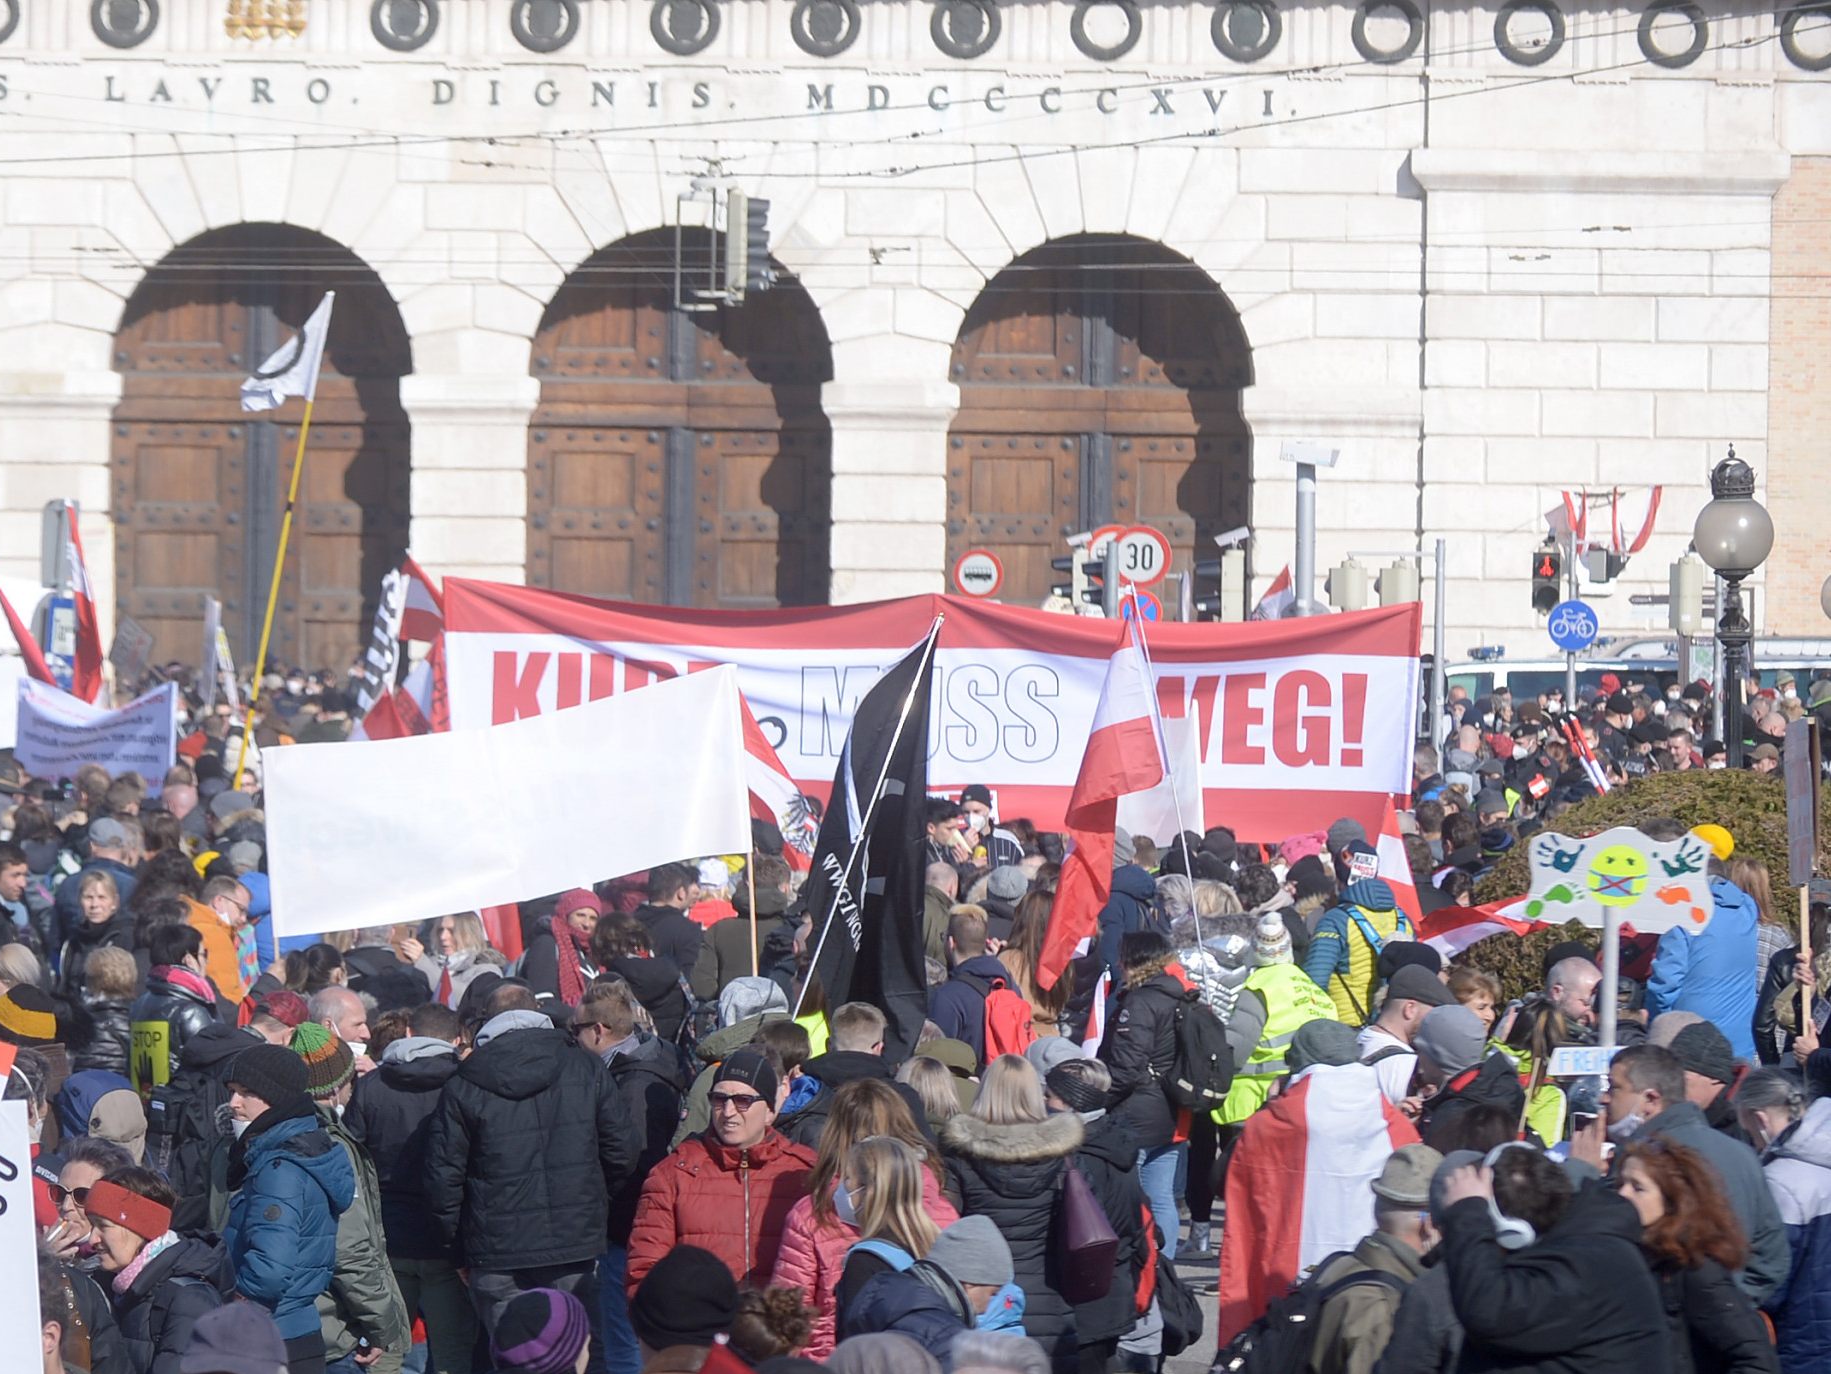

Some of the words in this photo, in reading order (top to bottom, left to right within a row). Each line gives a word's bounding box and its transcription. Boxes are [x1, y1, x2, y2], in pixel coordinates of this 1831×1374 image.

[1126, 543, 1153, 570] 30
[133, 1031, 162, 1049] STOP
[1559, 1050, 1613, 1073] FREIH
